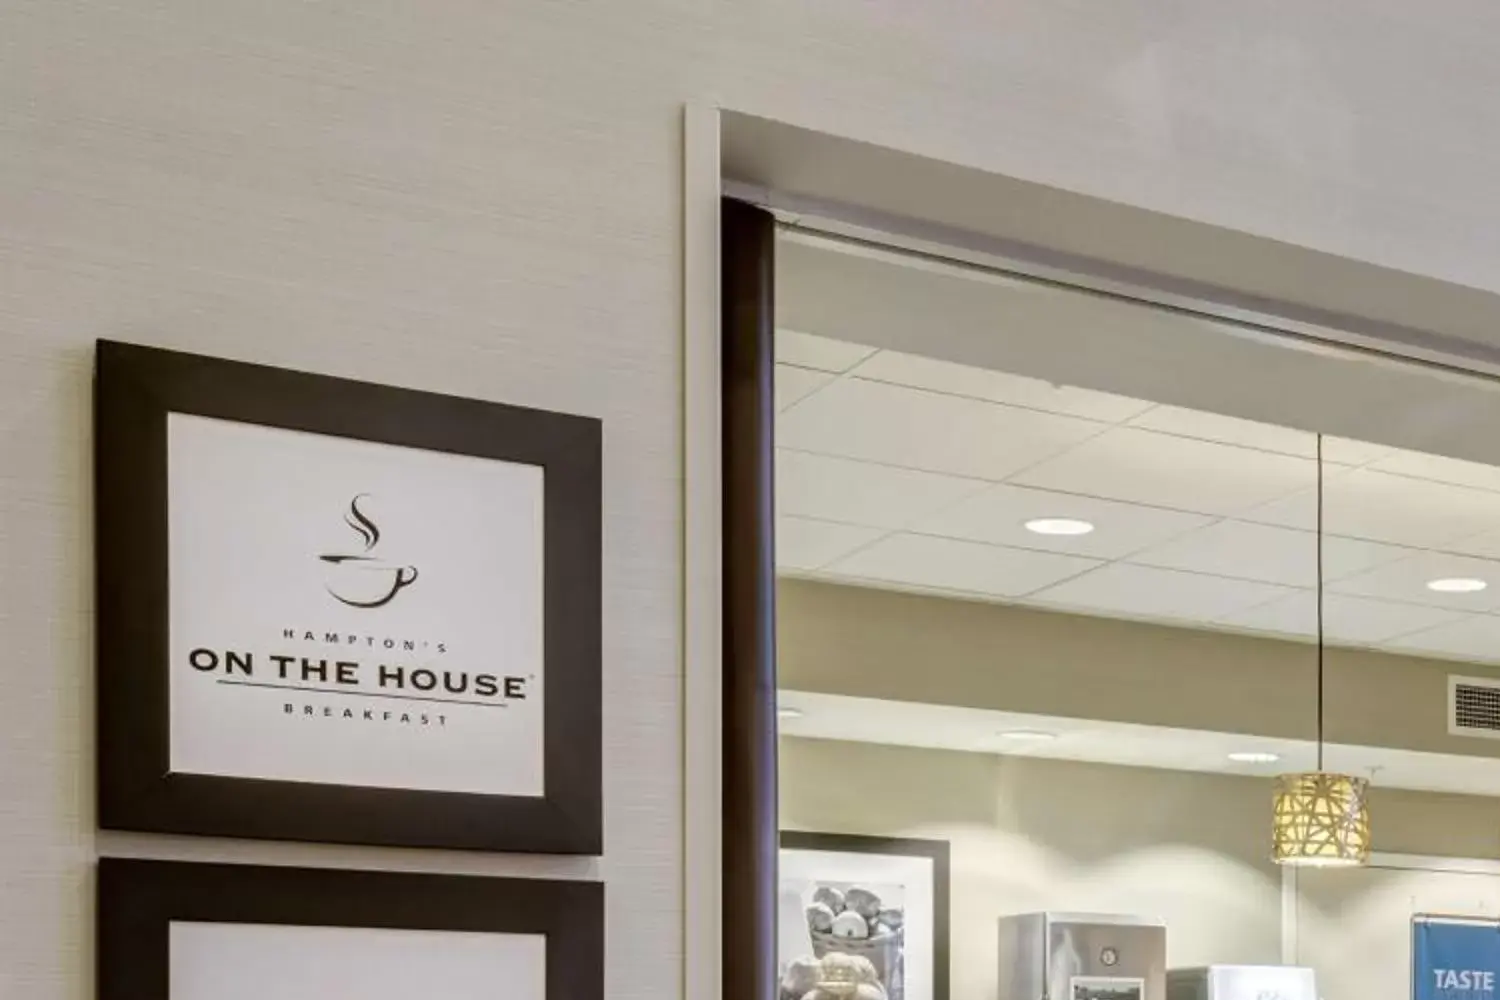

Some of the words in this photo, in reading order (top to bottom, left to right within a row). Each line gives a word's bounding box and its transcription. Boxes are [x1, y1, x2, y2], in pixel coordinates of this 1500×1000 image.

[283, 629, 447, 653] HAMPTON'S
[189, 648, 253, 675] ON
[269, 655, 359, 685] THE
[378, 665, 526, 699] HOUSE
[283, 703, 448, 726] BREAKFAST
[1433, 968, 1496, 991] TASTE
